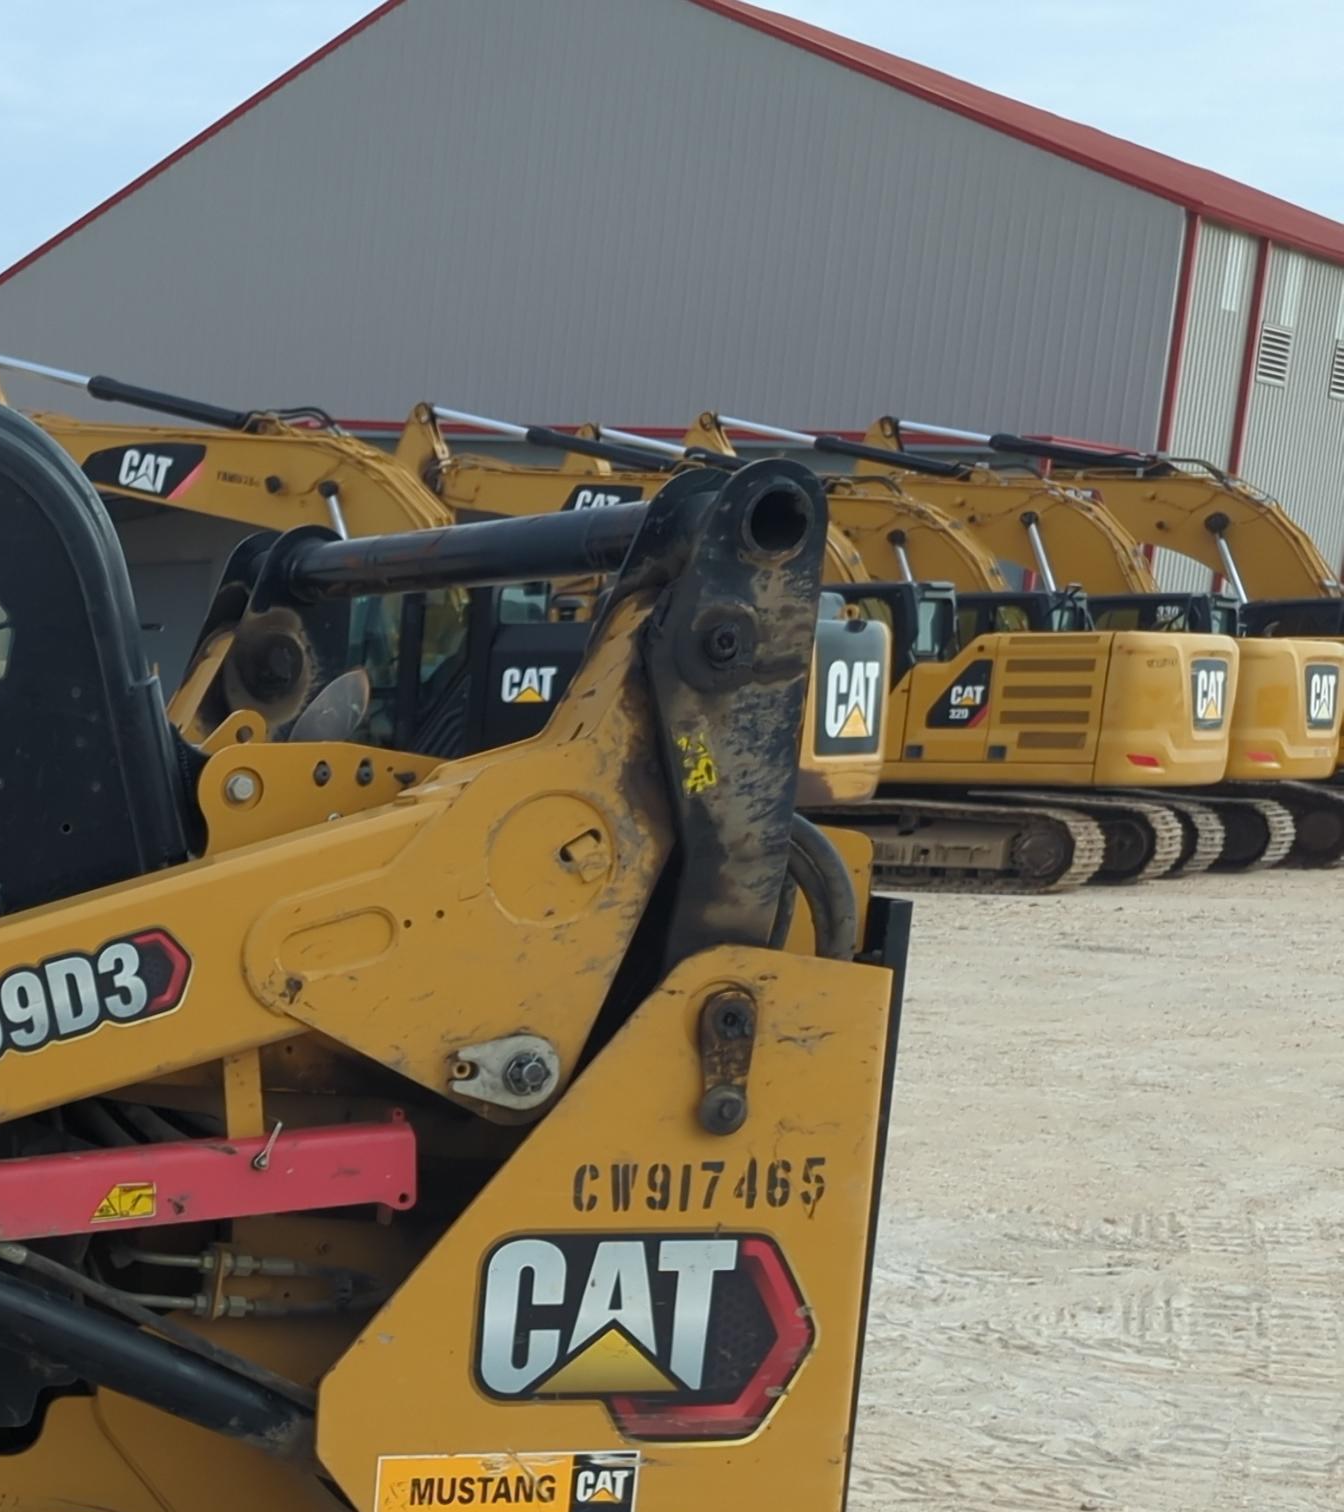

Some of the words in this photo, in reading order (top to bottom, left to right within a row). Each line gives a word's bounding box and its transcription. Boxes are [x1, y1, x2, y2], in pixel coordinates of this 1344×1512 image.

[118, 449, 174, 493] CAT
[501, 667, 558, 703] CAT
[825, 660, 880, 738] CAT
[950, 686, 985, 705] CAT
[1197, 670, 1224, 719] CAT
[1311, 674, 1336, 719] CAT
[573, 1157, 826, 1212] CW917465
[481, 1239, 738, 1394] CAT
[409, 1475, 556, 1506] MUSTANG
[575, 1470, 629, 1502] CAT
